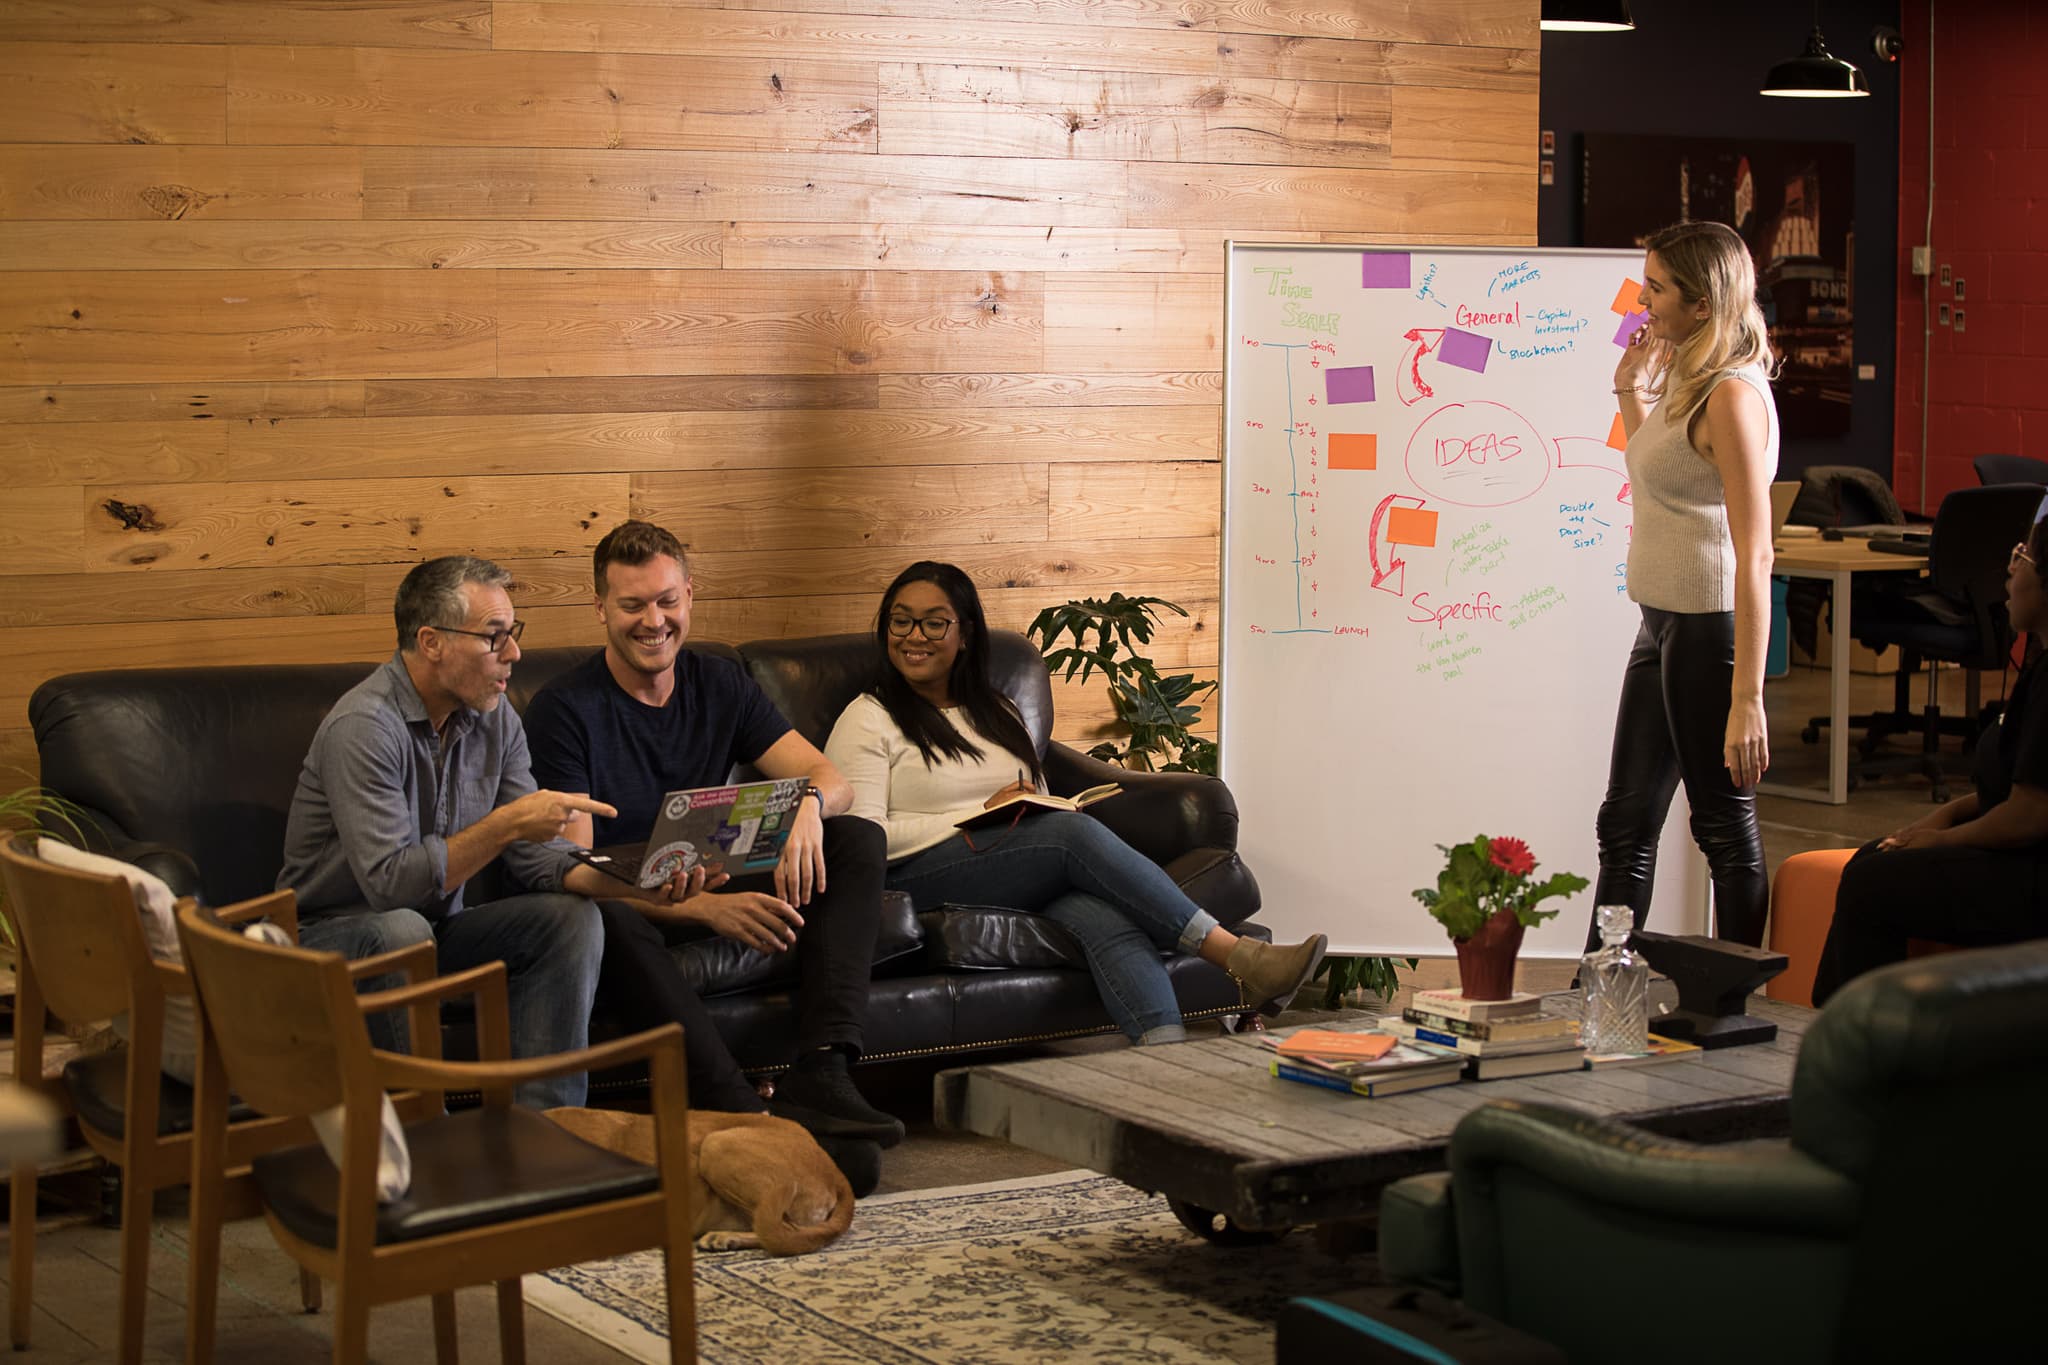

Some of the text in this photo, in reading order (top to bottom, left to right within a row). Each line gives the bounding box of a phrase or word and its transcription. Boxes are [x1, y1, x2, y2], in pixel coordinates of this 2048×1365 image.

[1498, 261, 1529, 278] MORE
[1501, 269, 1542, 293] MARKETS
[1456, 301, 1521, 328] General
[1435, 433, 1522, 467] IDEAS
[1407, 592, 1502, 630] Specific
[1334, 625, 1369, 638] LAUNCH
